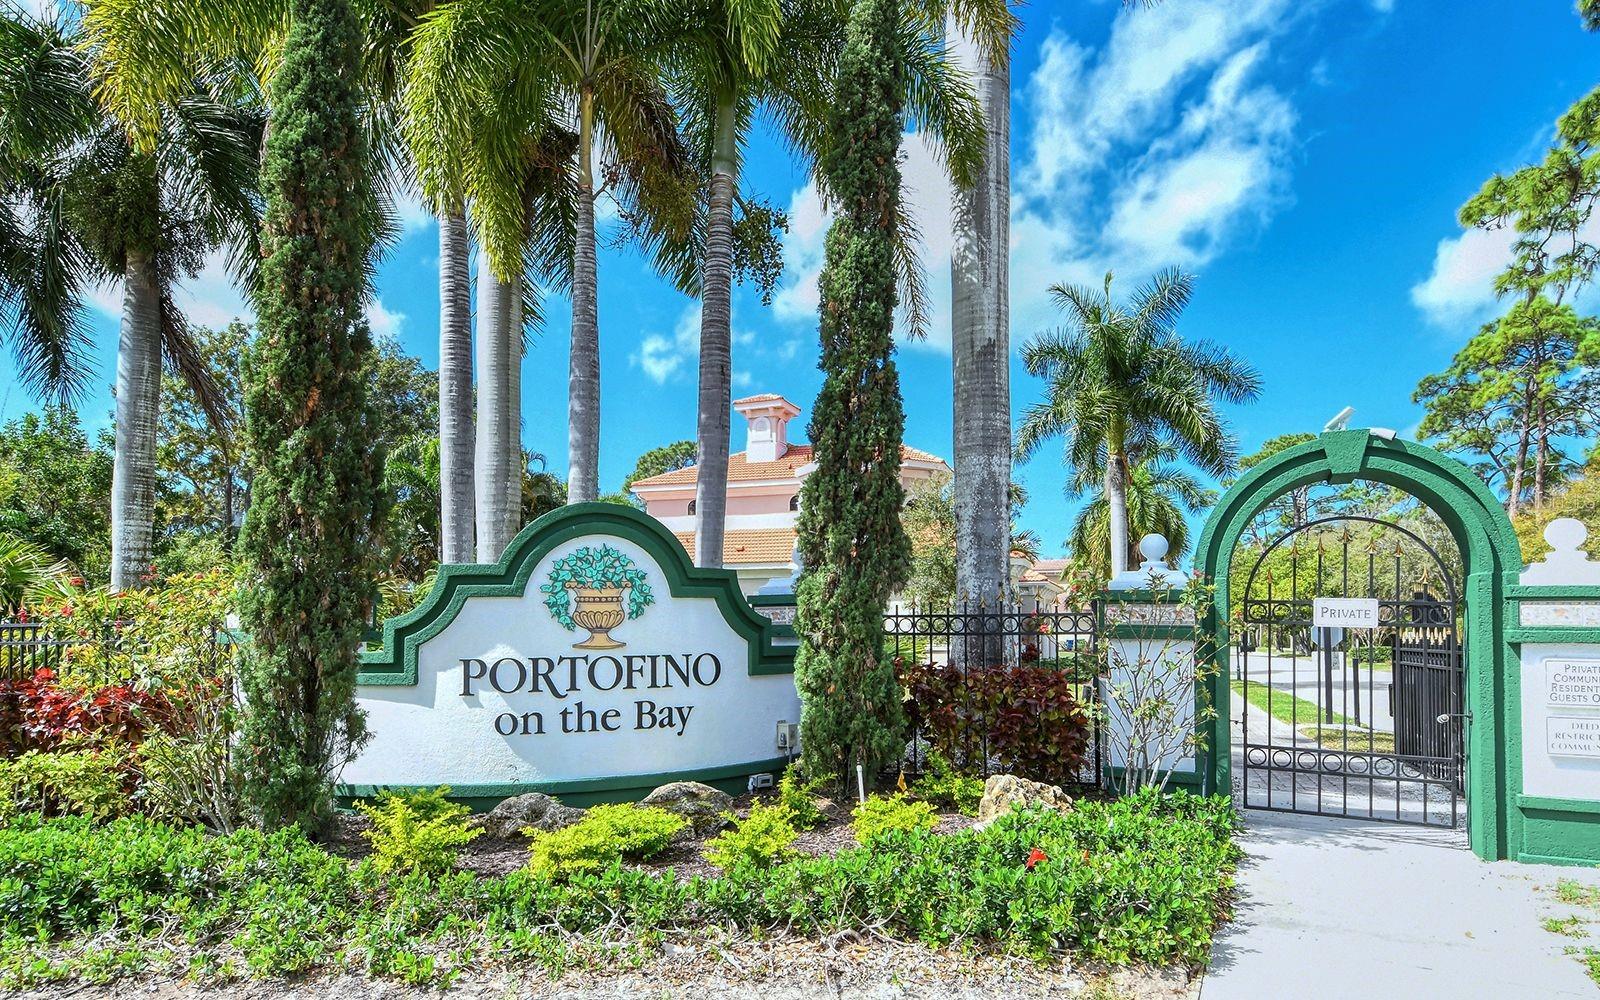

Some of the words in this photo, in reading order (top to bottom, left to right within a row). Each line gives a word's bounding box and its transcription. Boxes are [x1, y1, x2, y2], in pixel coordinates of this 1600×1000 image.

[1321, 606, 1372, 619] PRIVATE
[458, 652, 722, 699] PORTOFINO
[1549, 692, 1588, 703] GUESTS
[494, 711, 546, 736] on
[559, 701, 622, 733] the
[633, 700, 695, 737] Bay
